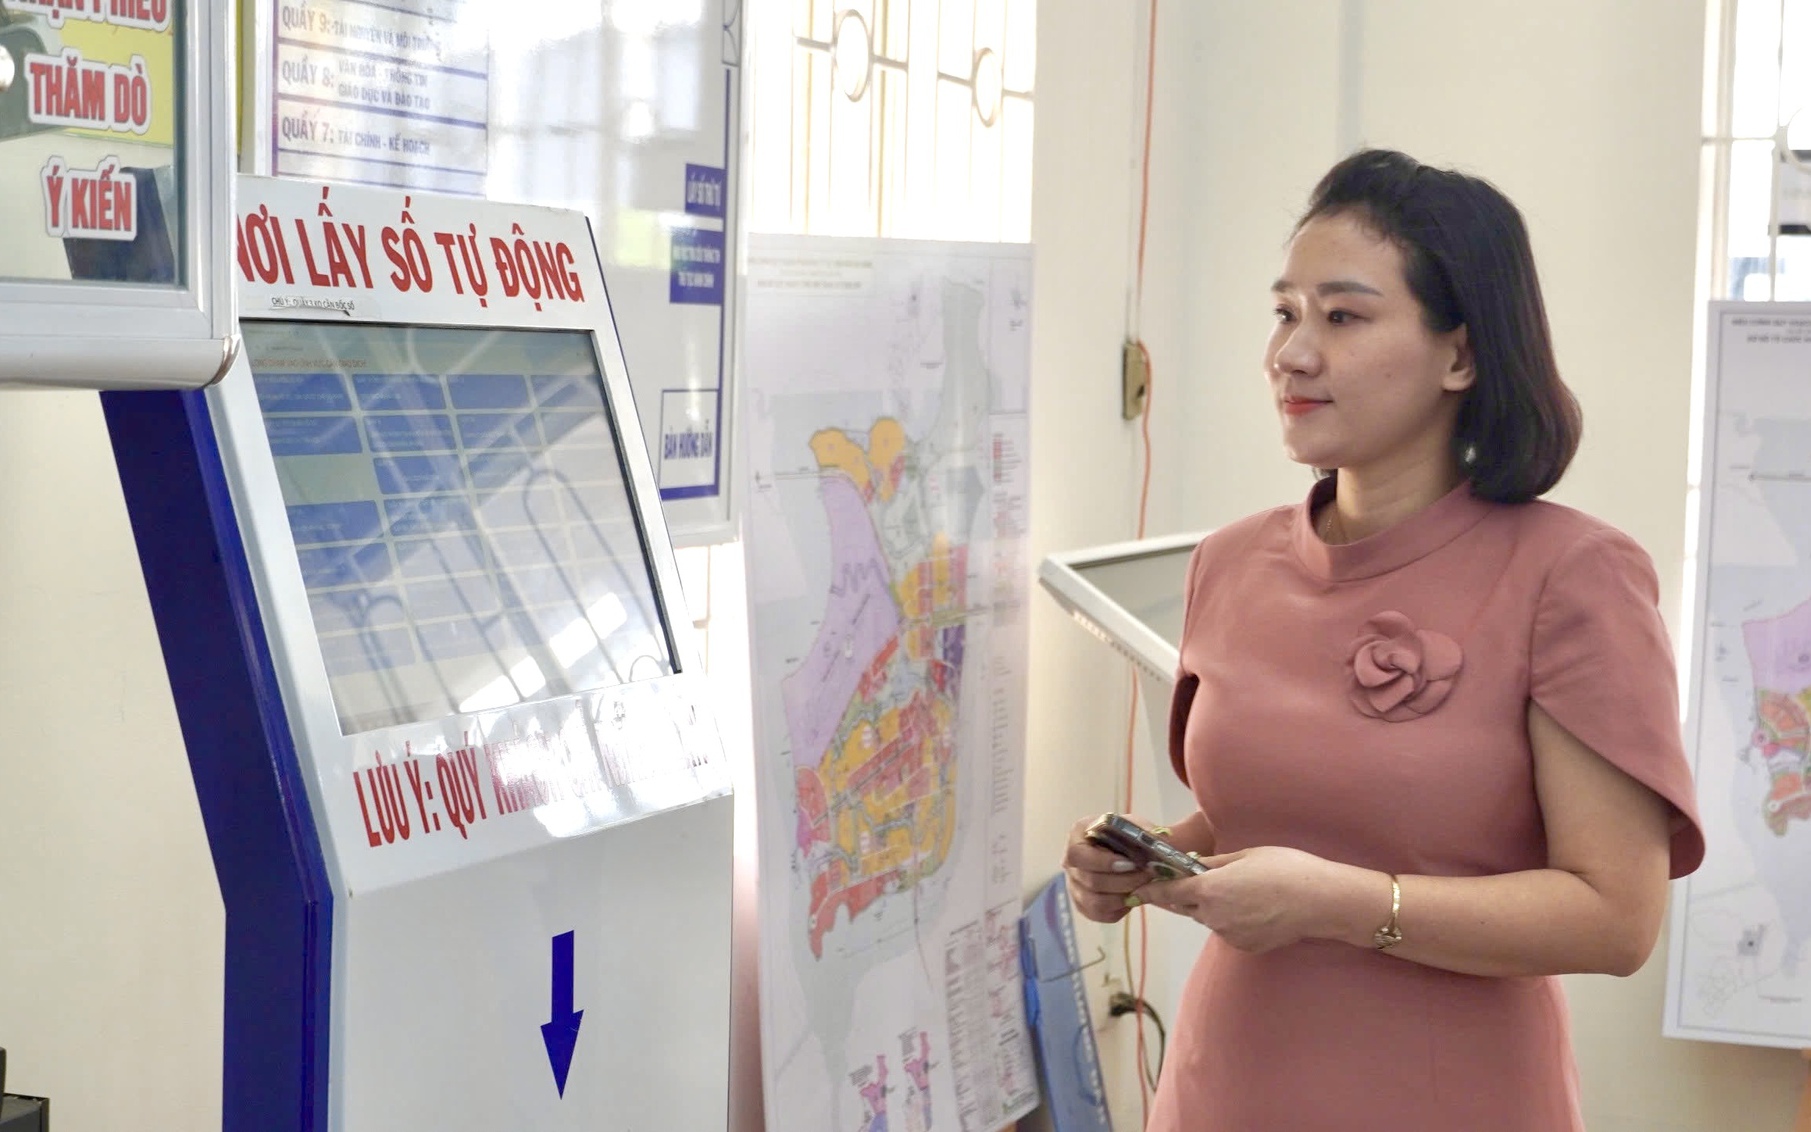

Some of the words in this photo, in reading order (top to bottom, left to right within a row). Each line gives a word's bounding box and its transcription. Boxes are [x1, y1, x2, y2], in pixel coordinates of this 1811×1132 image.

[30, 56, 105, 122] THĂM
[113, 64, 148, 127] DÒ
[322, 66, 334, 88] 8:
[322, 121, 334, 144] 7:
[47, 165, 65, 228] Ý
[71, 164, 132, 231] KIẾN
[294, 186, 374, 288] LẤY
[381, 196, 433, 293] SỐ
[434, 223, 488, 308] TỰ
[489, 222, 585, 311] ĐỘNG
[353, 750, 410, 848] LƯU
[403, 740, 441, 834] Ý:
[436, 731, 487, 840] QUÝ
